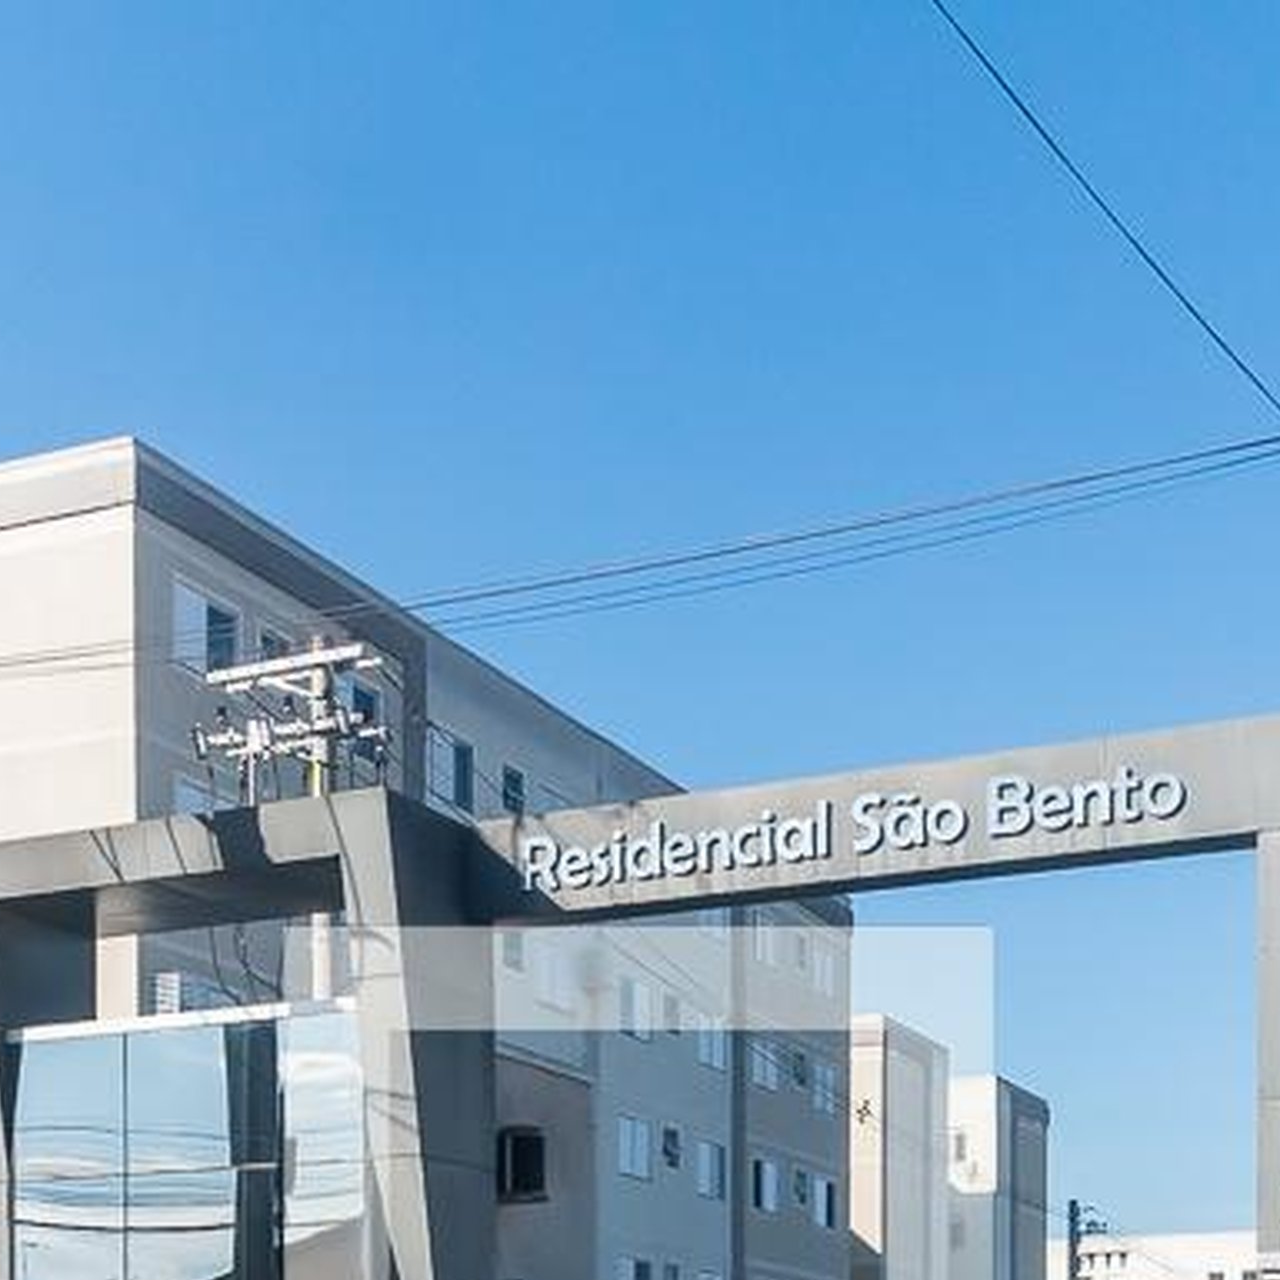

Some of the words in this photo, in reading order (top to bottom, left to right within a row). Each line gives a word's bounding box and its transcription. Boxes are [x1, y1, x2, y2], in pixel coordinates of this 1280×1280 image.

[522, 800, 832, 892] Residencial
[852, 791, 969, 853] São
[986, 767, 1186, 839] Bento
